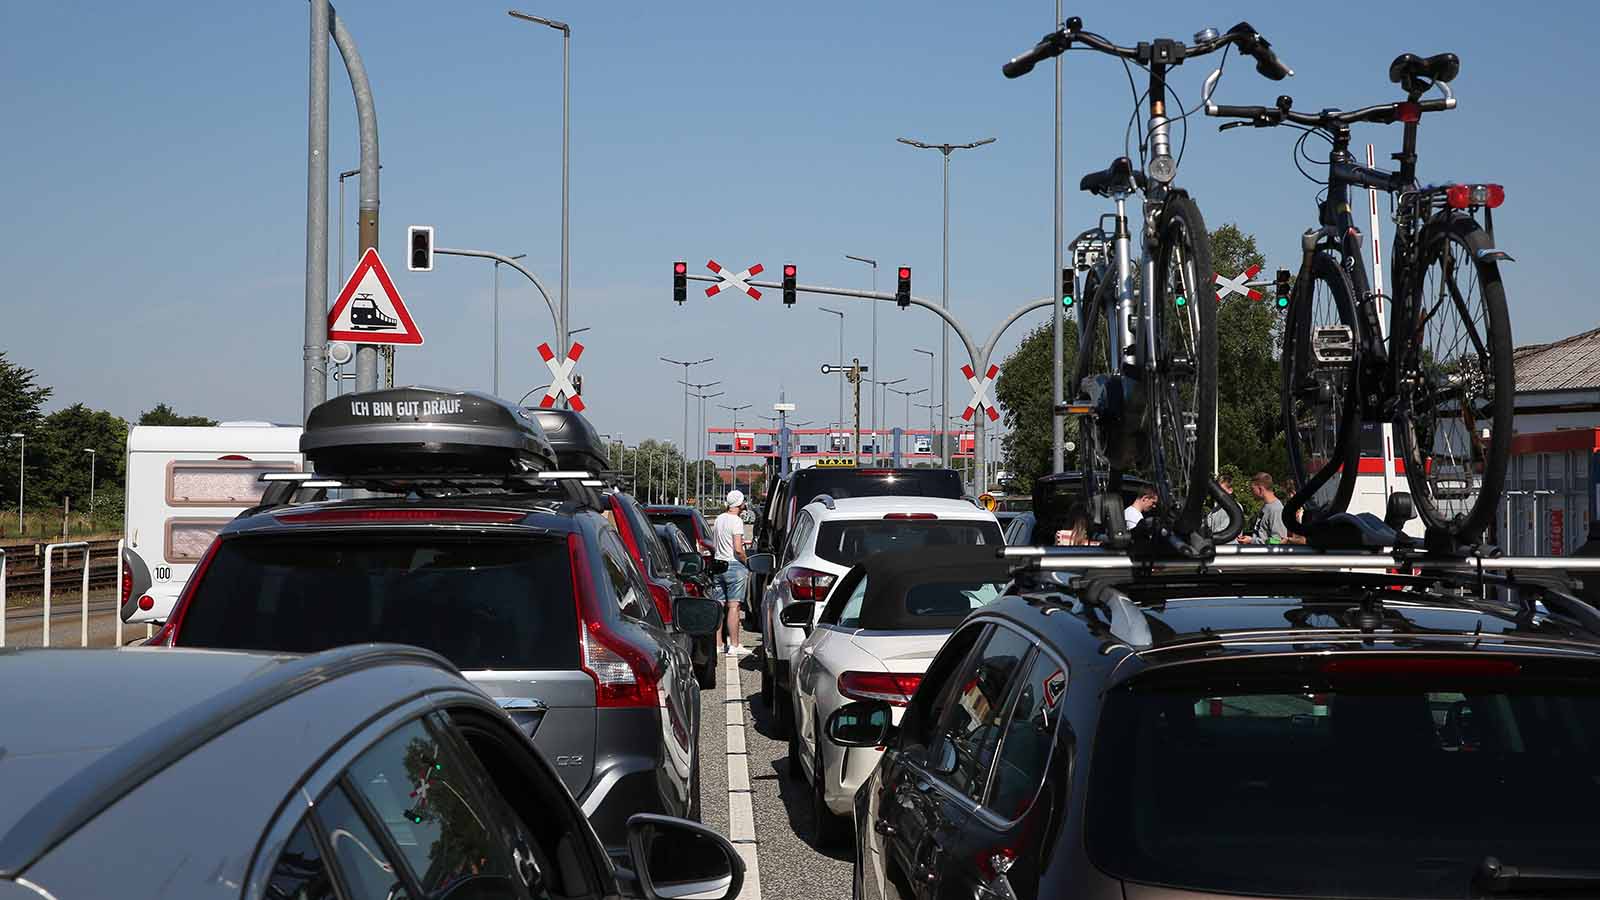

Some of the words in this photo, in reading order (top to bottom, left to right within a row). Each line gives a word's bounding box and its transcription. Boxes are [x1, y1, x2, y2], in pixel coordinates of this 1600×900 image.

[351, 401, 370, 416] ICH
[372, 401, 393, 417] BIN
[396, 401, 419, 416] GUT
[423, 399, 464, 416] DRAUF.
[819, 458, 853, 466] TAXI
[155, 567, 170, 579] 100
